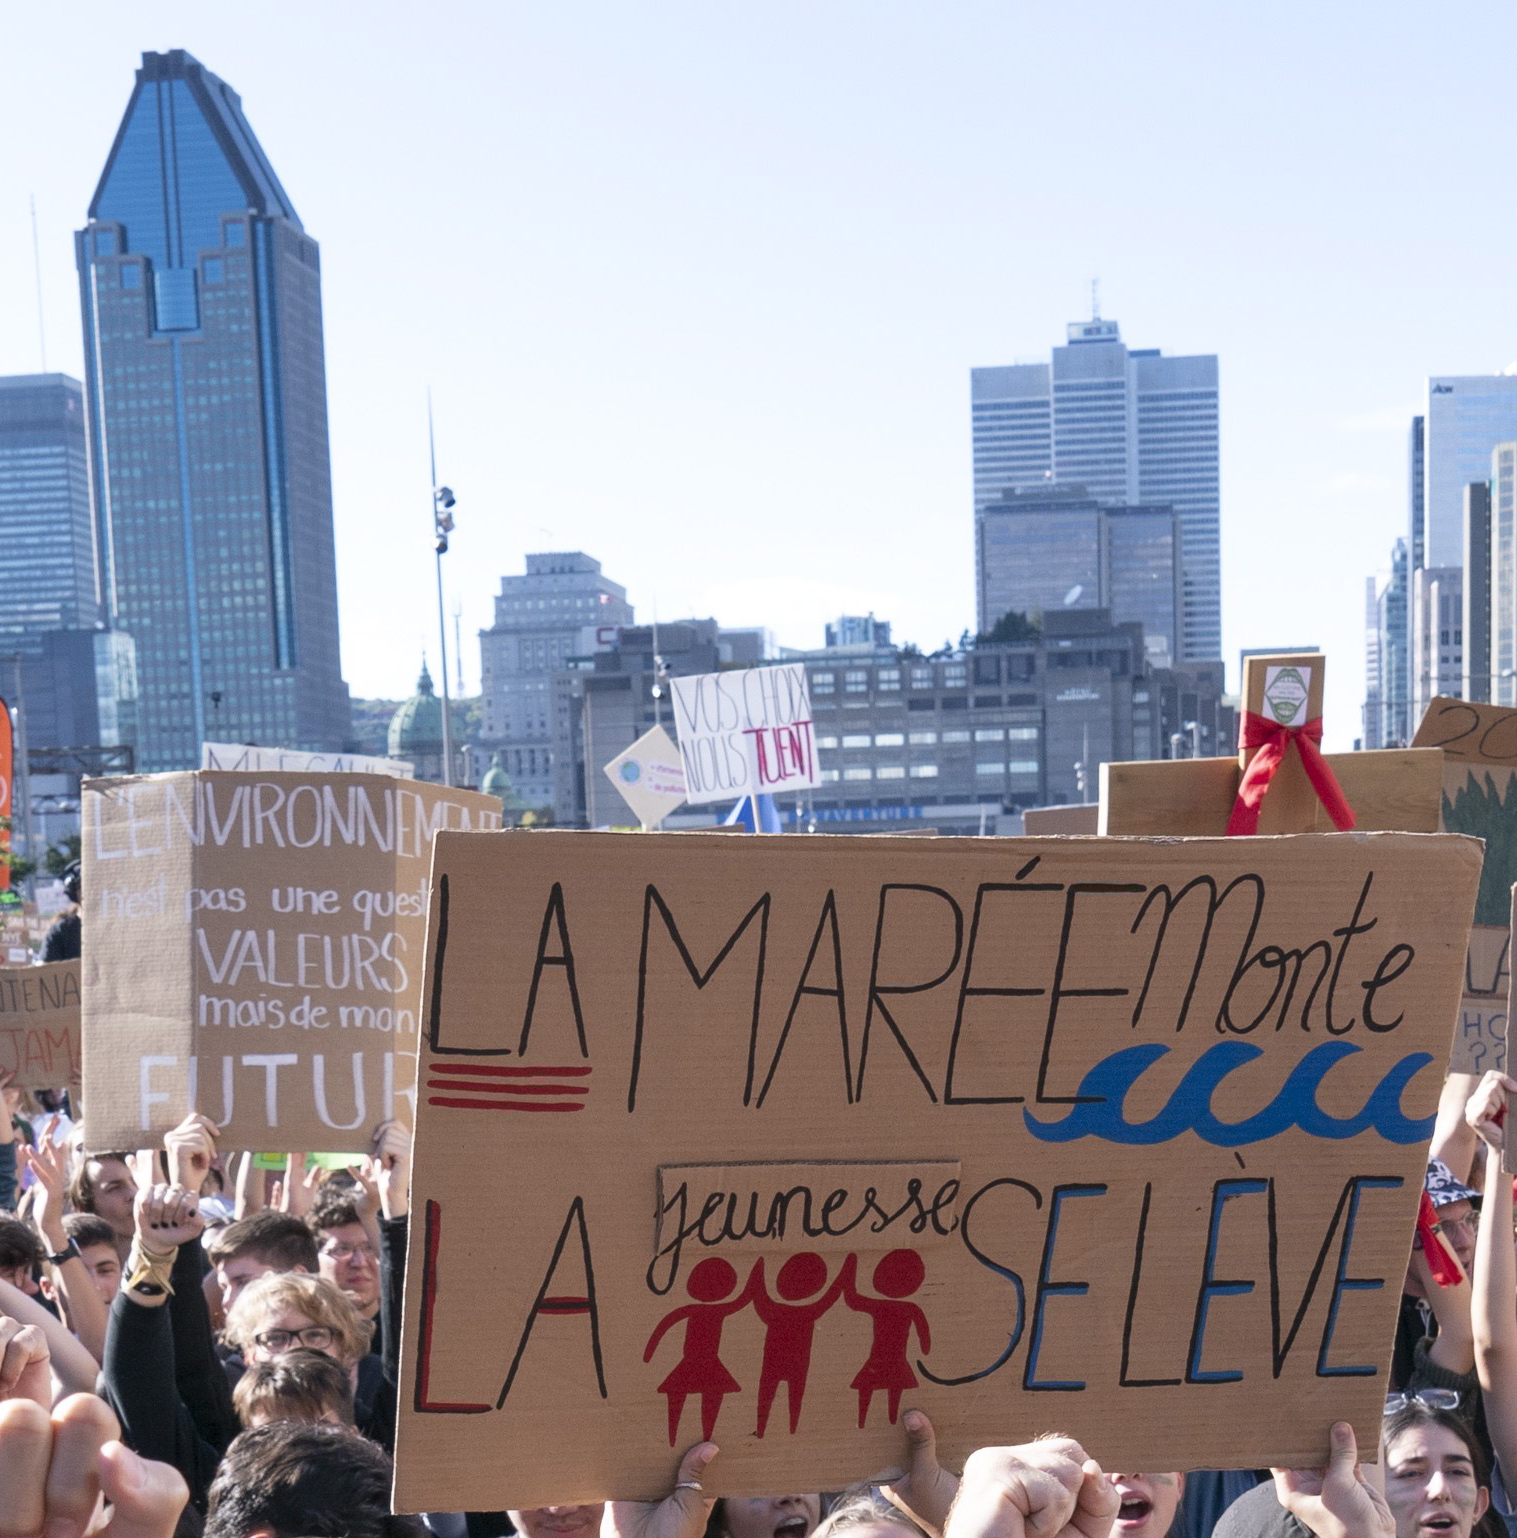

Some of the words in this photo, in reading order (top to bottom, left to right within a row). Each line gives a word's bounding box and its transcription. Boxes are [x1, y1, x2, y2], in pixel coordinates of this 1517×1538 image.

[673, 669, 742, 735] VOS
[740, 664, 812, 730] CHOIX
[679, 729, 749, 794] NOUS
[742, 720, 816, 789] TUENT
[184, 886, 247, 923] pas
[272, 887, 341, 915] une
[197, 927, 408, 993] VALEURS
[429, 872, 589, 1059] LA
[627, 855, 1148, 1113] MARÉE
[199, 993, 283, 1029] mais
[290, 995, 331, 1028] de
[339, 1003, 414, 1033] mon
[413, 1196, 608, 1414] LA
[646, 1172, 961, 1295] jeunesse
